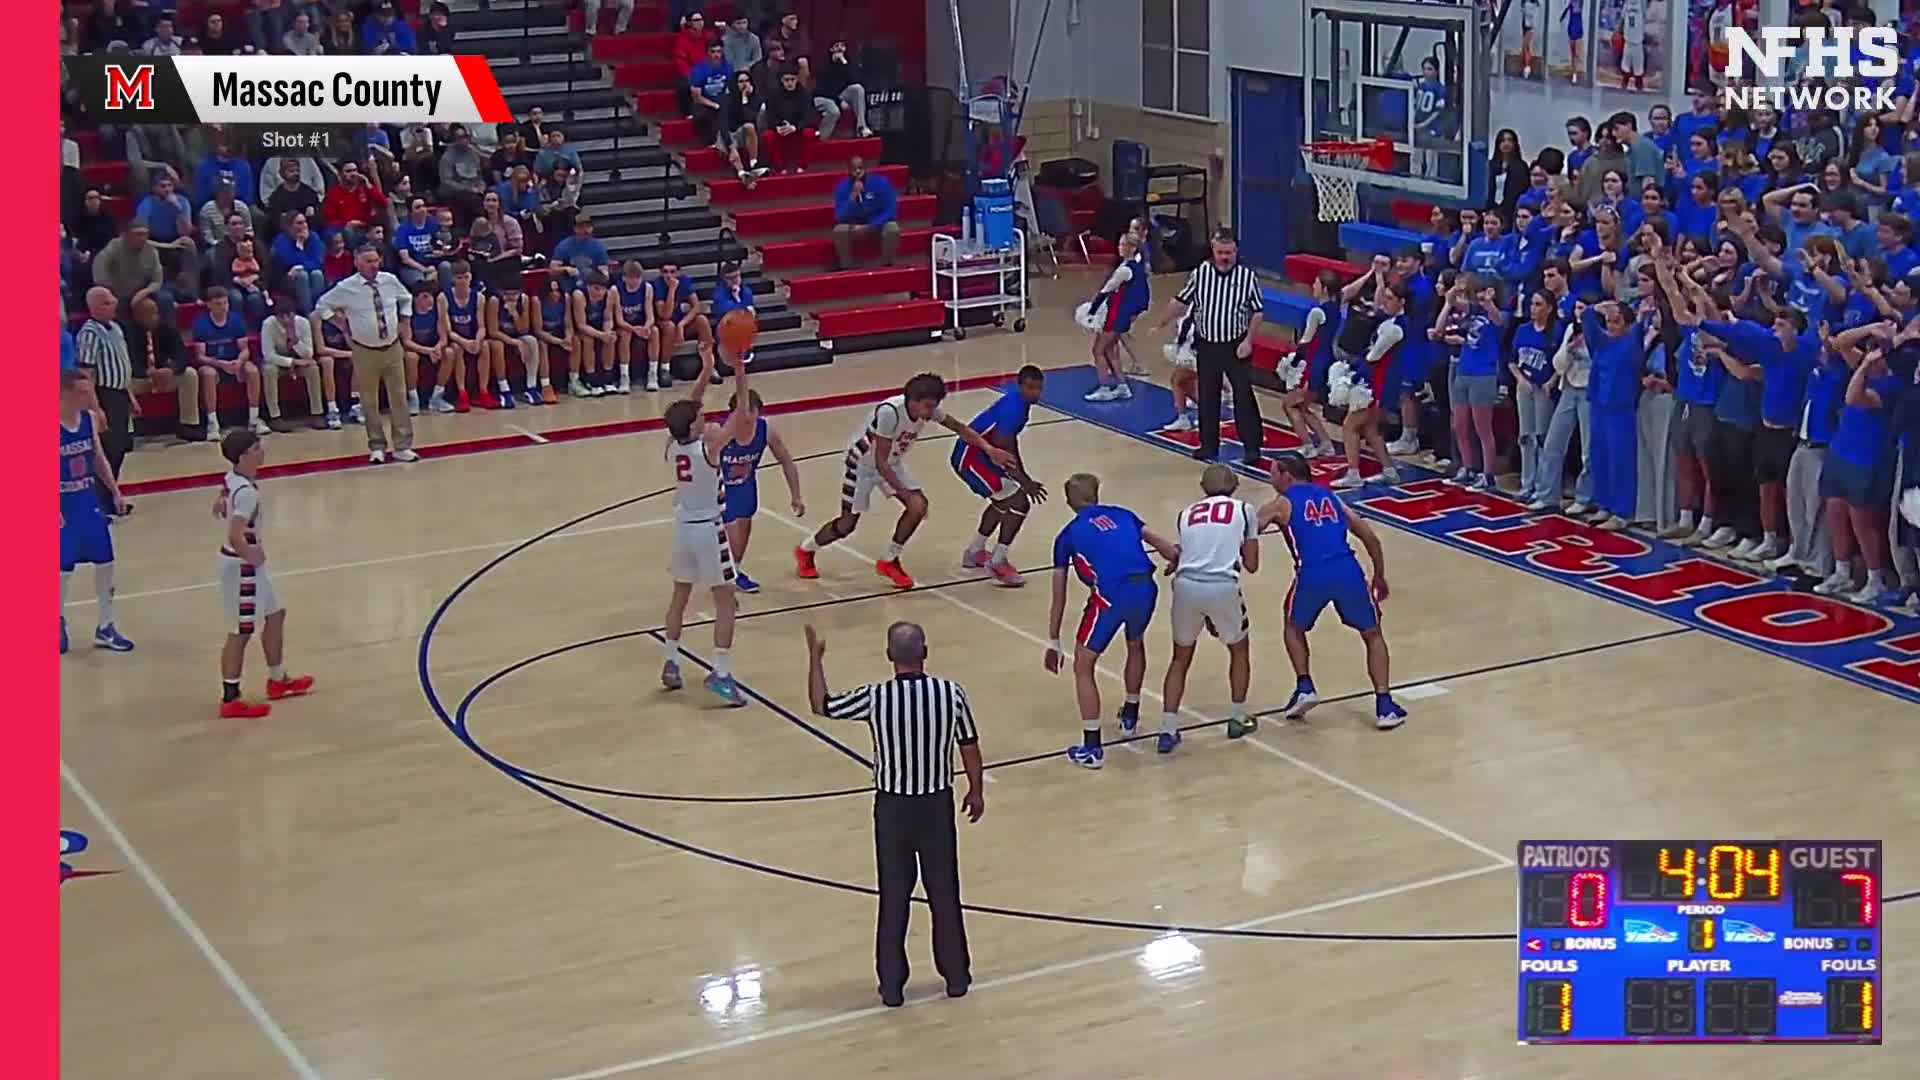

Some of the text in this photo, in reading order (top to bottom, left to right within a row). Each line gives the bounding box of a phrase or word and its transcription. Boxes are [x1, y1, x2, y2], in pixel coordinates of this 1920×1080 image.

[675, 454, 693, 482] 2
[1187, 500, 1235, 527] 20
[1304, 496, 1339, 528] 44
[1523, 845, 1610, 868] PATRIOTS
[1789, 847, 1876, 868] GUEST
[1657, 844, 1782, 900] 4:04
[1569, 872, 1607, 928] 0
[1677, 905, 1726, 915] PERIOD
[1840, 873, 1873, 926] 7
[1565, 938, 1617, 951] BONUS
[1702, 918, 1714, 950] 1
[1784, 938, 1834, 951] BONUS
[1520, 959, 1578, 973] FOULS
[1667, 959, 1731, 973] PLAYER
[1821, 959, 1877, 972] FOULS
[1559, 982, 1573, 1033] 1
[1860, 981, 1873, 1030] 1
